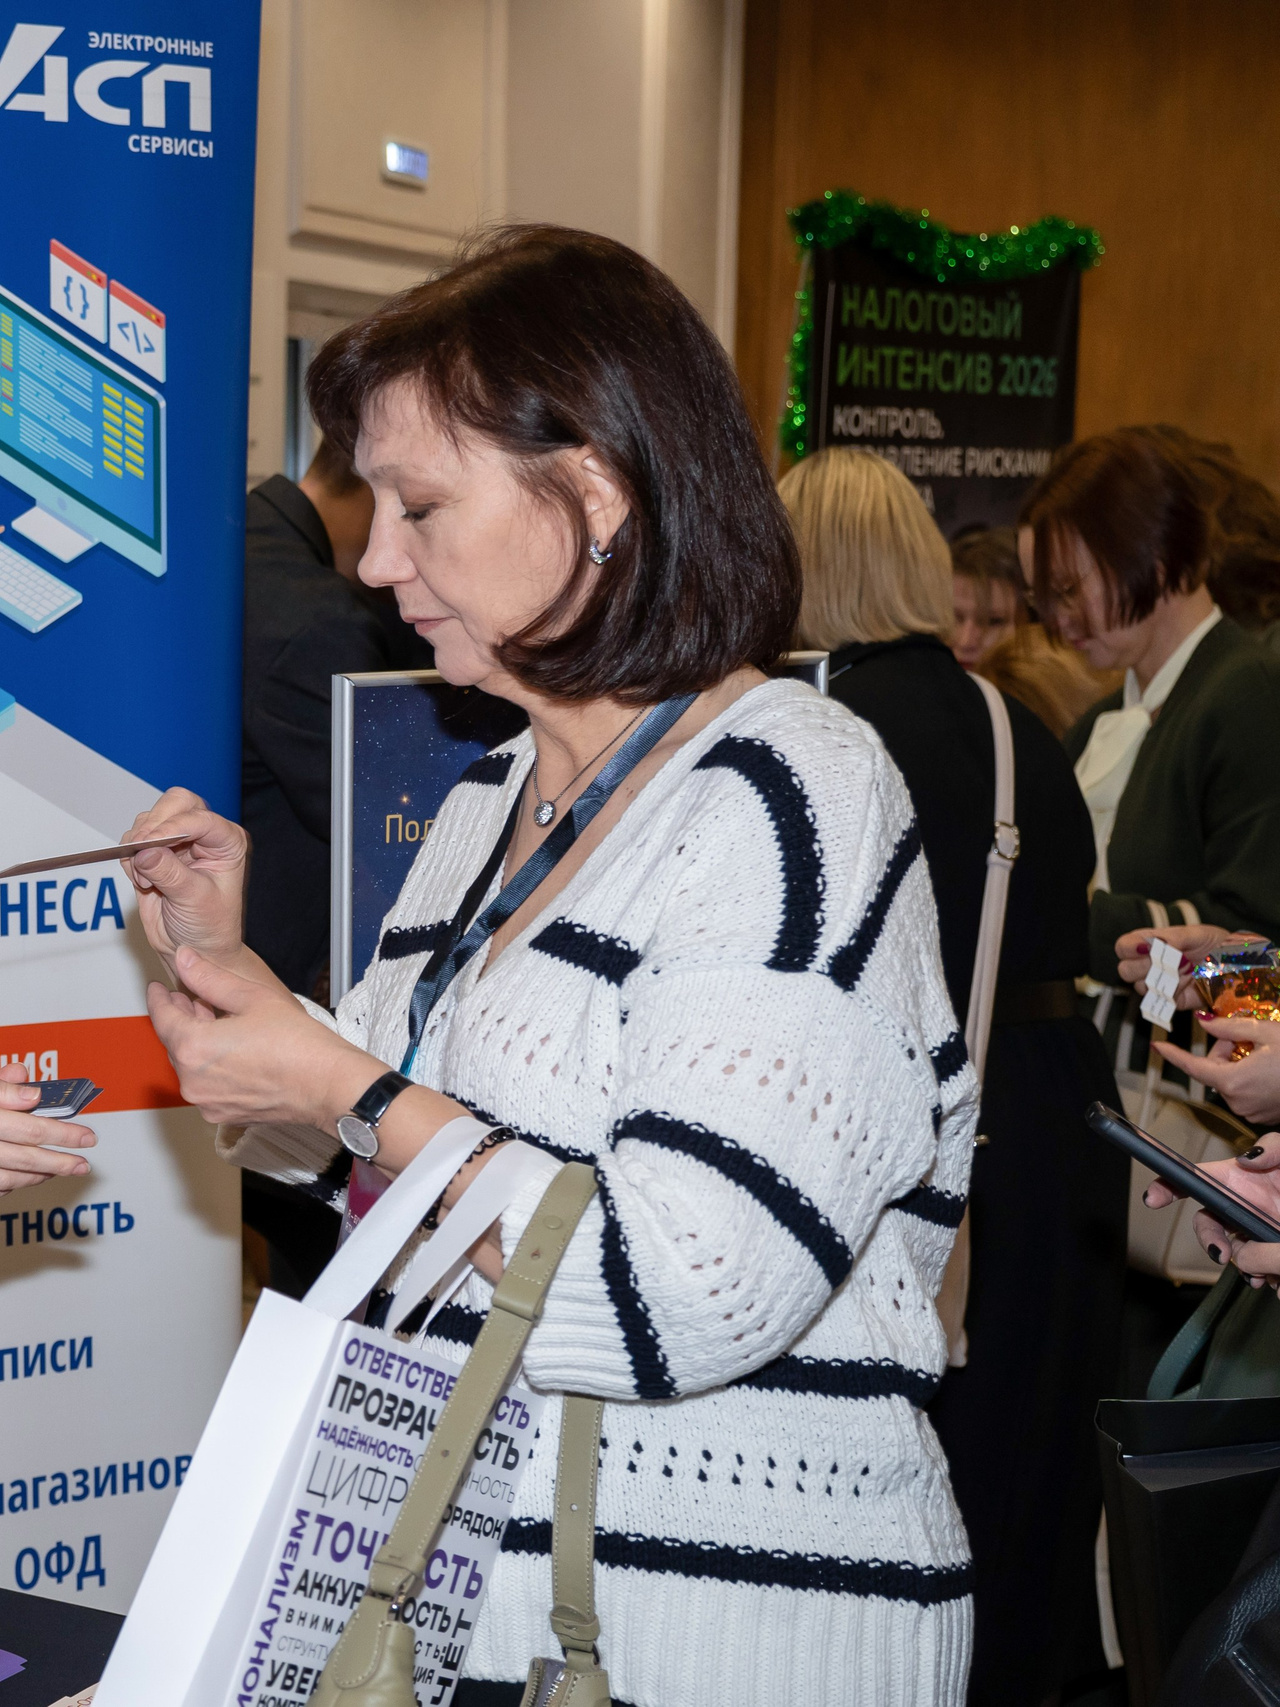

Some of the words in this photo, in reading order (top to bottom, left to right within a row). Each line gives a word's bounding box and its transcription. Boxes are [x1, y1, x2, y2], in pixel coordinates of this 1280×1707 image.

[88, 31, 214, 58] ЭЛЕКТРОННЫЕ
[127, 134, 214, 159] СЕРВИСЫ
[841, 285, 1024, 340] НАЛОГОВЫЙ
[836, 343, 993, 394] ИНТЕНСИВ
[998, 355, 1058, 397] 2026
[343, 1337, 530, 1430] ОТВЕТСТВЕСТЬ
[317, 1420, 414, 1469] НАДЁЖНОСТЬ
[441, 1503, 505, 1541] ОРЯДОК
[14, 1534, 107, 1591] ОФД
[311, 1513, 483, 1600] ТОЧСТЬ
[293, 1569, 451, 1634] АККУРОСТЬ
